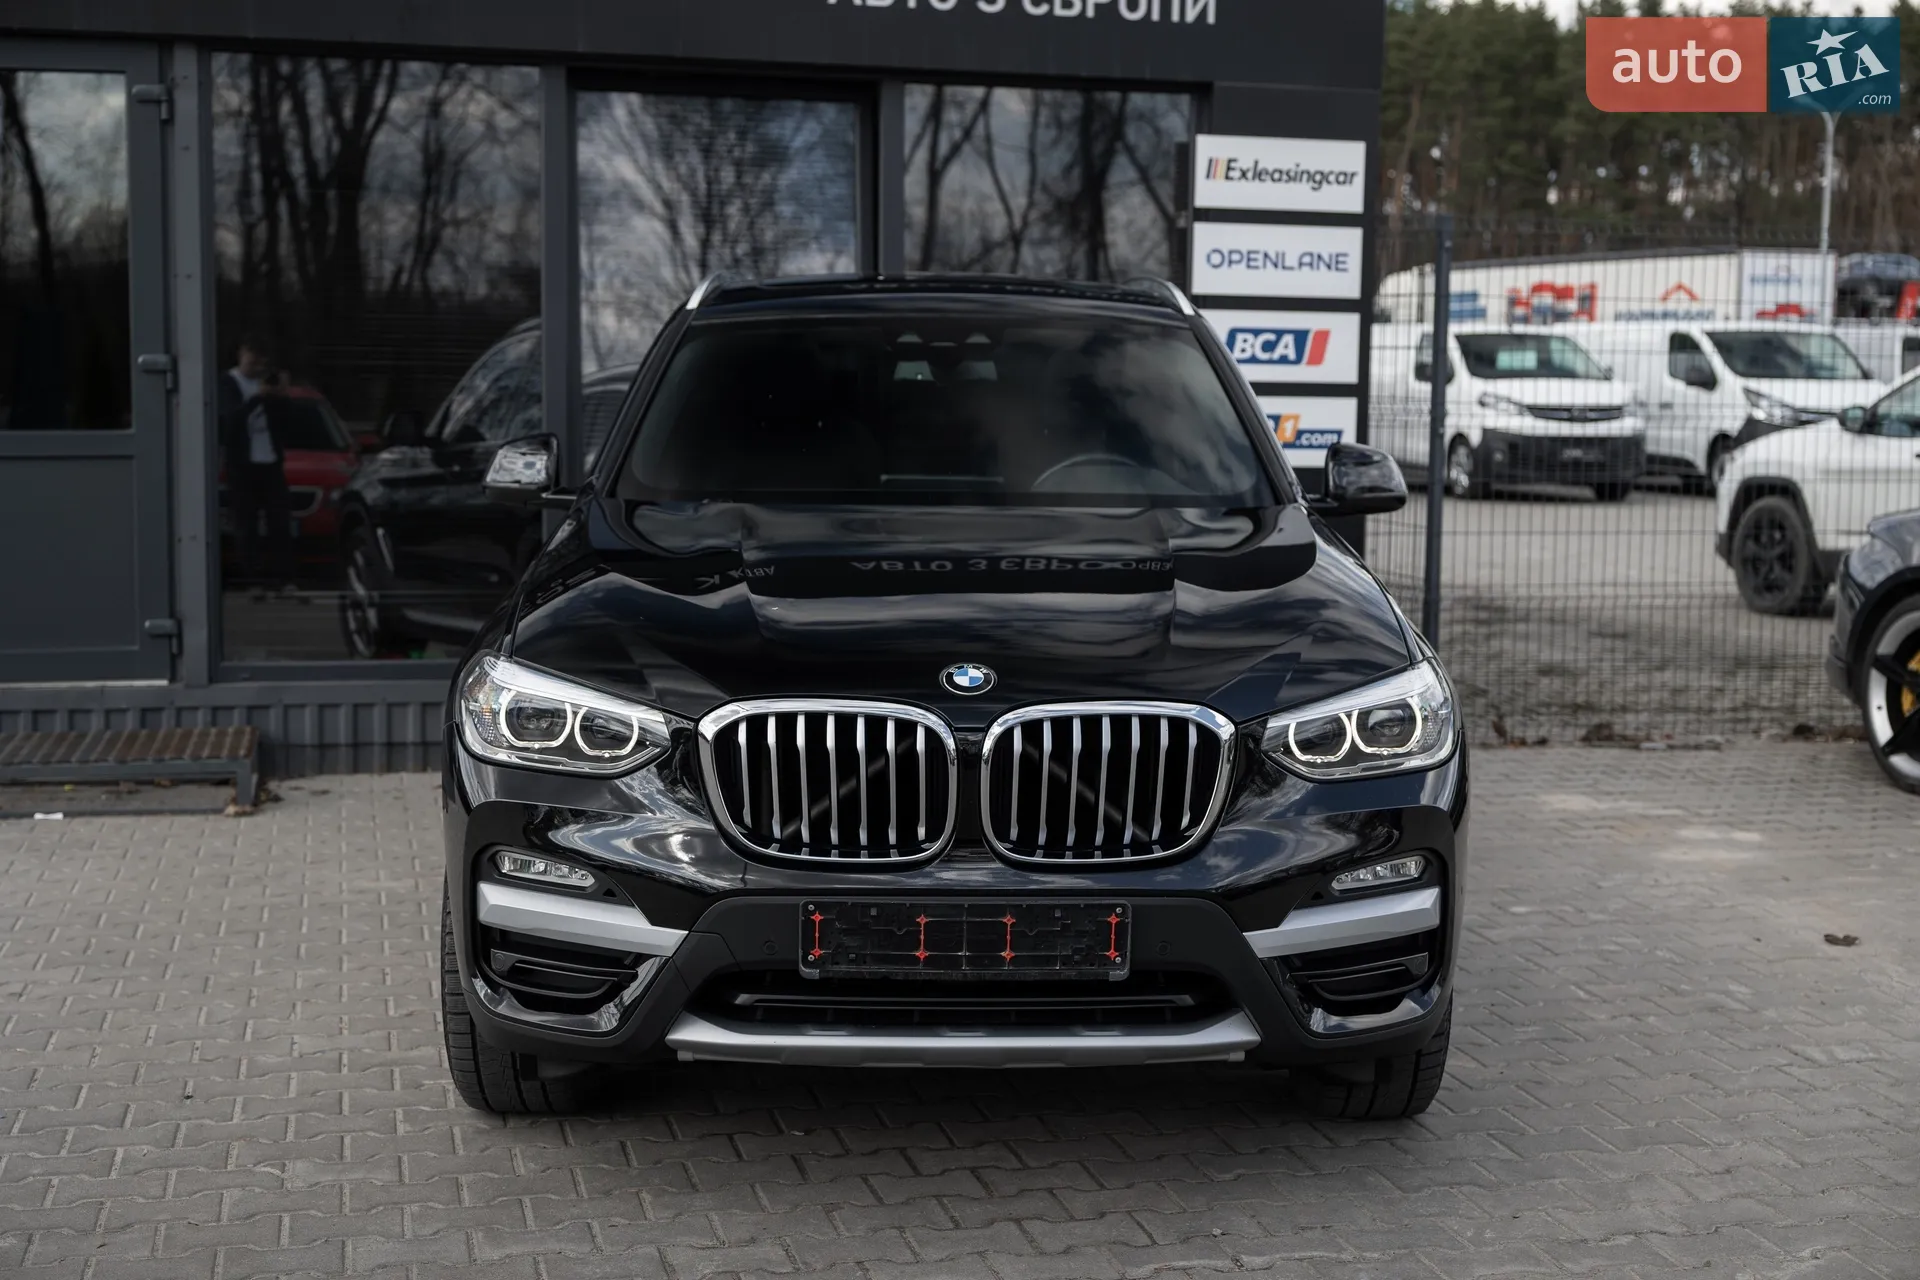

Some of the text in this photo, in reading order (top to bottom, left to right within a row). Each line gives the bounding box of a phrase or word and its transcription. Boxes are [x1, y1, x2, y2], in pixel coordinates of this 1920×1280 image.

[1224, 157, 1358, 191] Exleasingcar
[1206, 248, 1350, 273] OPENLANE
[1232, 332, 1297, 360] BCA
